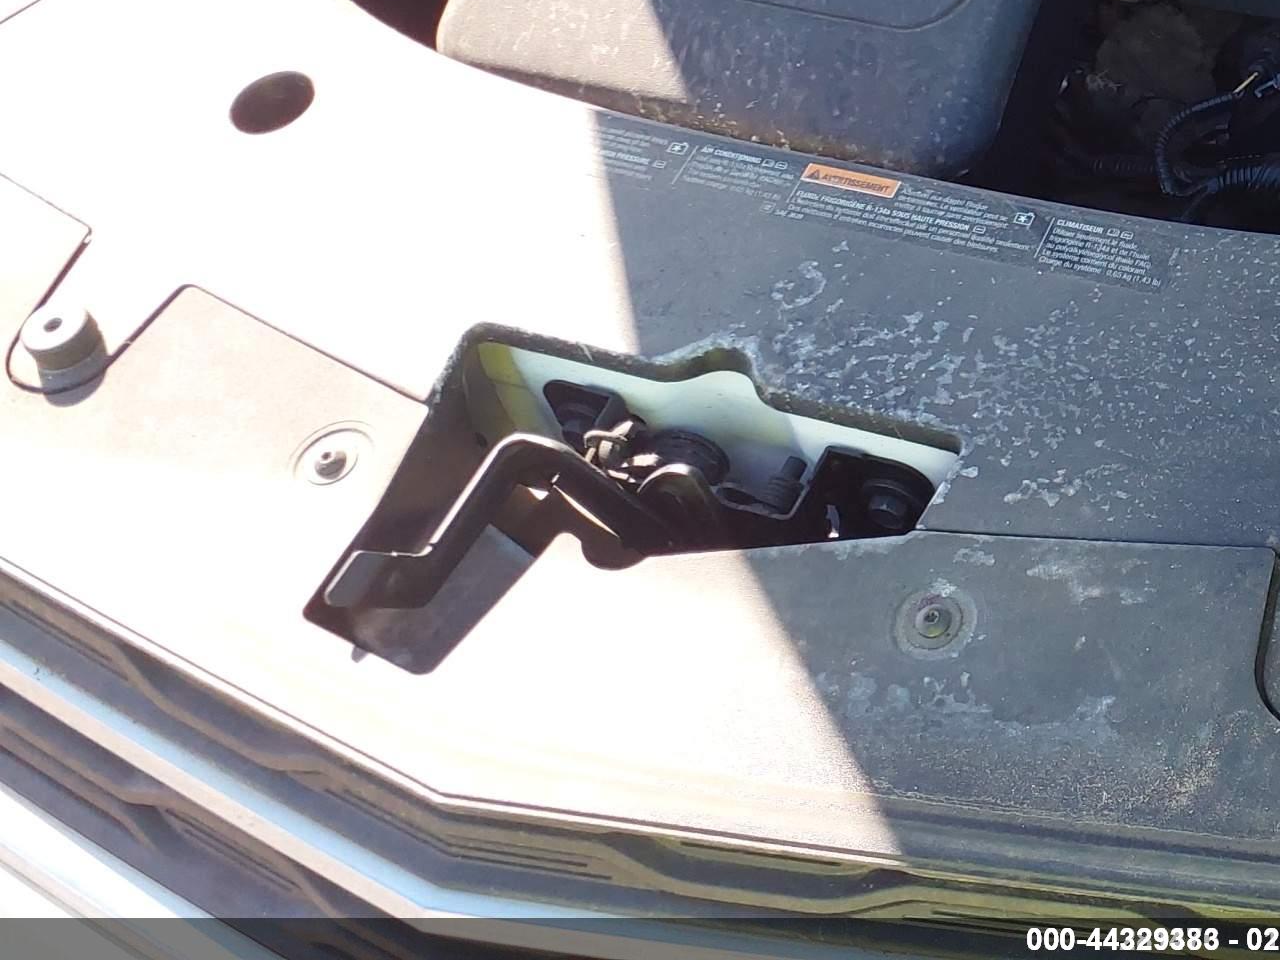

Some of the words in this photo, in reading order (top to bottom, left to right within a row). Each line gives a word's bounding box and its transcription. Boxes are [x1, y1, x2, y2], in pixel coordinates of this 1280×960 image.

[821, 173, 890, 193] AVERTISSEMENT
[890, 209, 912, 220] SOUS
[910, 214, 936, 224] HAUTE
[934, 219, 970, 231] PRESSION
[1056, 219, 1104, 234] CLIMATISEUR
[1038, 255, 1064, 267] Charge
